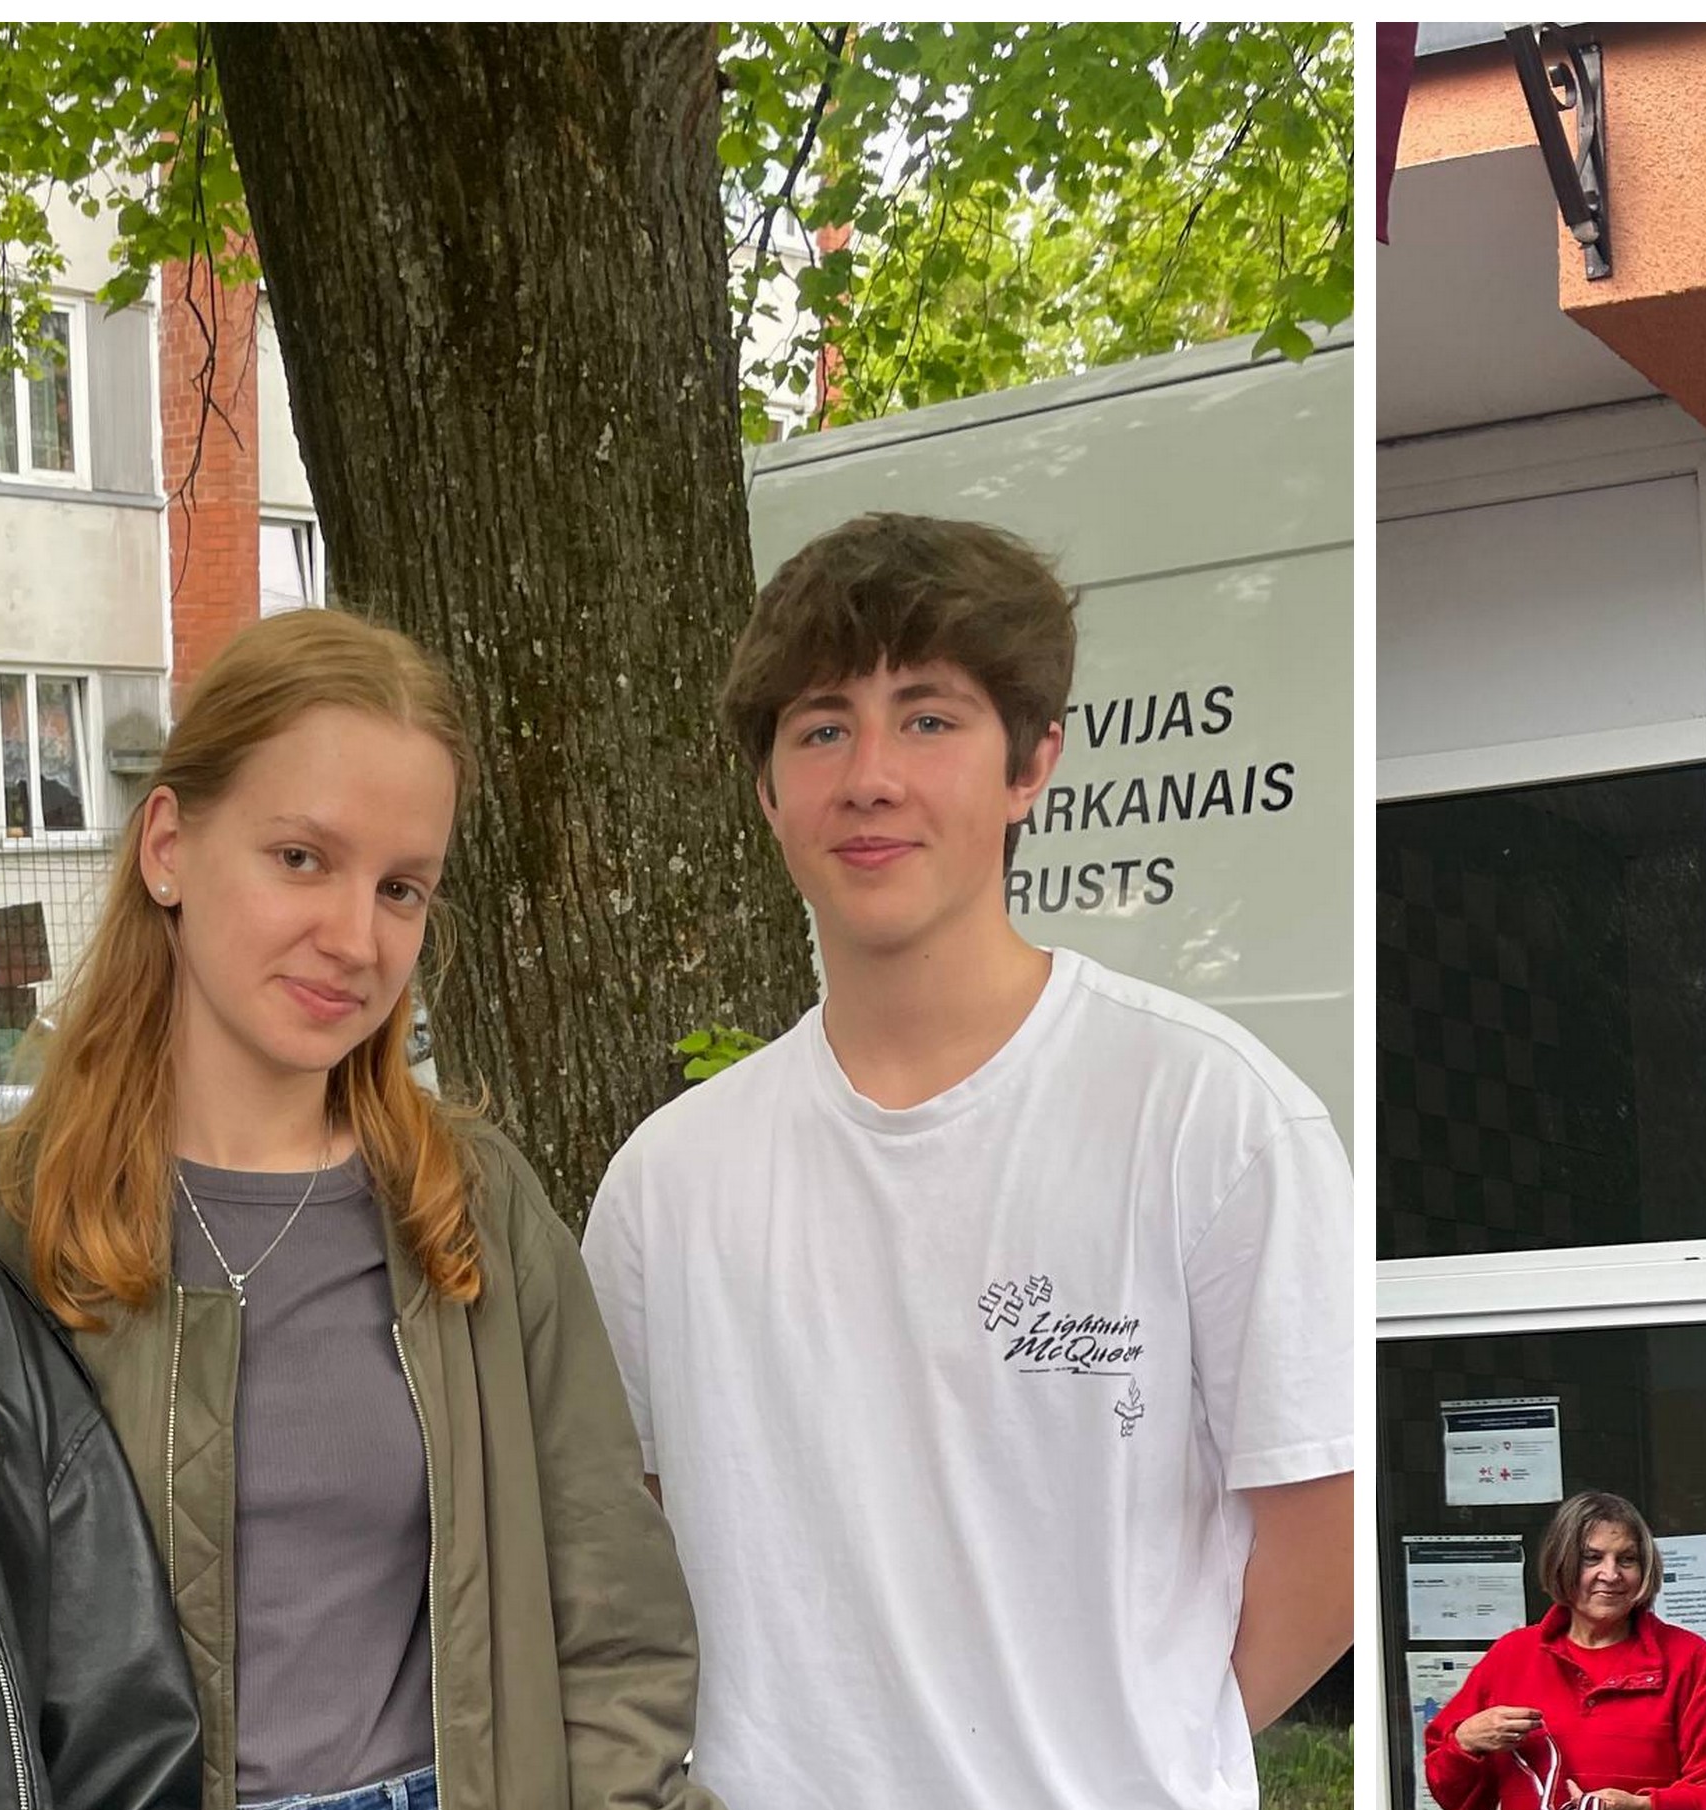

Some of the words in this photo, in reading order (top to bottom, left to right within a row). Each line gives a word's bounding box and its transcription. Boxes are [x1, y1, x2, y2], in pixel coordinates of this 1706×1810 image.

[1061, 685, 1234, 753] VIJAS
[1022, 761, 1295, 836] RKANAIS
[1005, 857, 1176, 915] RUSTS
